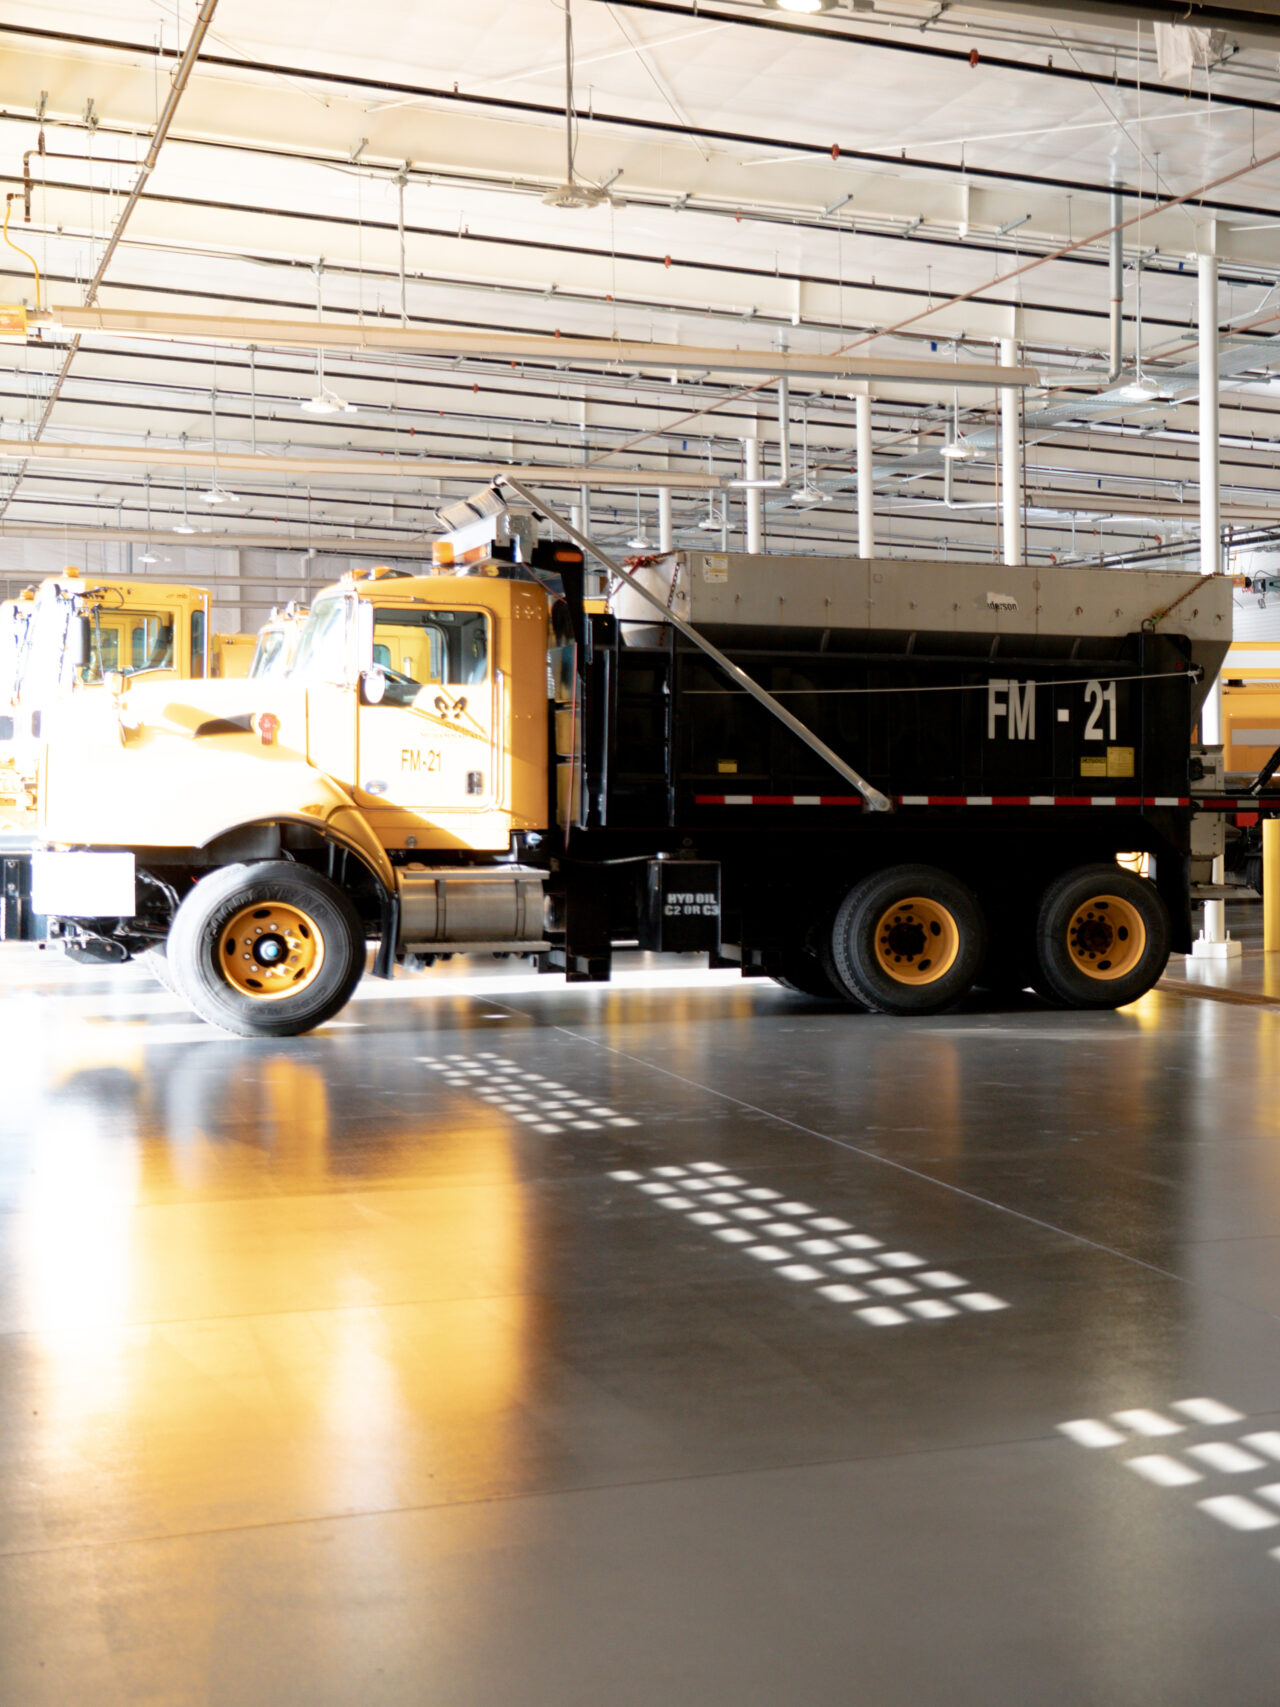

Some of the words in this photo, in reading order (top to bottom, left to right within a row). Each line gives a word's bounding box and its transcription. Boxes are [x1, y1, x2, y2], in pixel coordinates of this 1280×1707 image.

[988, 678, 1036, 740] FM
[1084, 680, 1117, 740] 21
[401, 749, 442, 771] FM-21
[667, 893, 694, 904] HYD
[695, 893, 717, 904] OIL
[664, 905, 681, 916] C2
[684, 905, 701, 915] OR
[702, 905, 720, 916] C3
